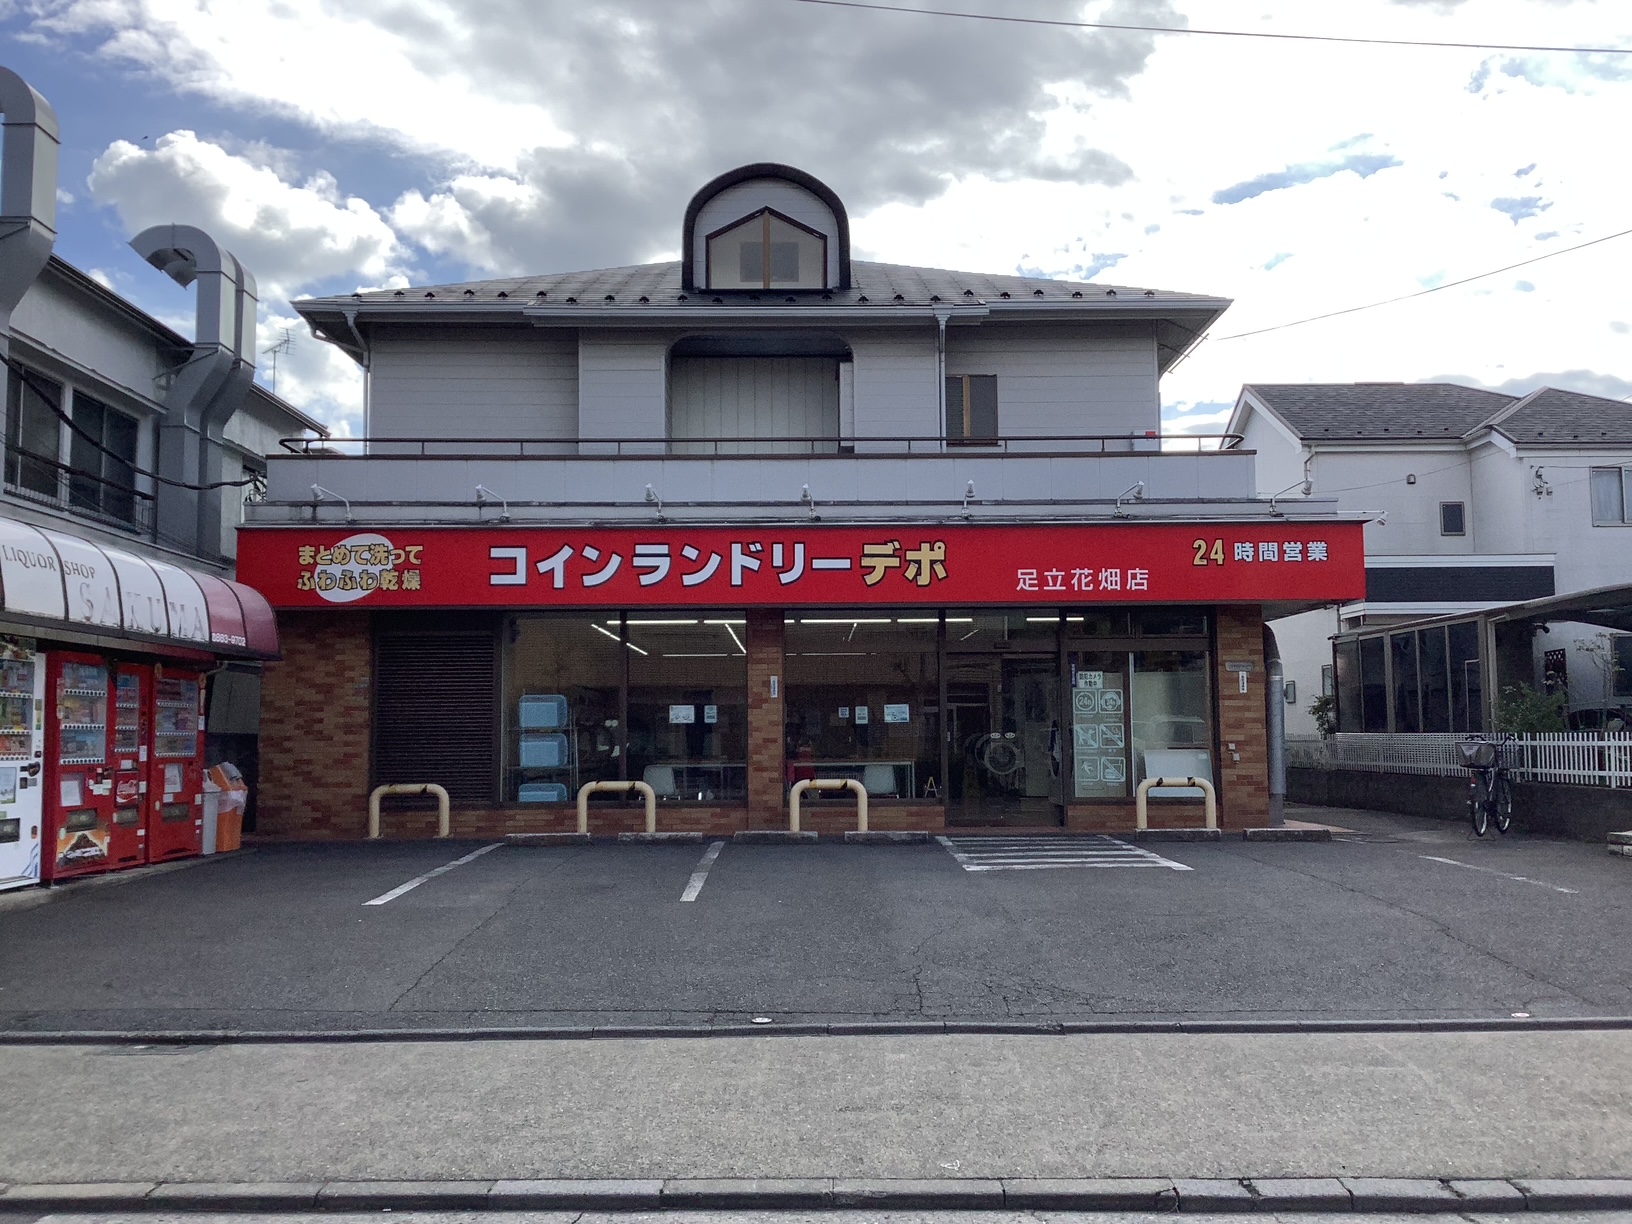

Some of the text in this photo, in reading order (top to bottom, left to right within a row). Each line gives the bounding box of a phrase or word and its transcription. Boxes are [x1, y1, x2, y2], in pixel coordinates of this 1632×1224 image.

[2, 545, 96, 579] LIQUOR SHOP
[297, 543, 424, 566] まとめて洗って
[488, 541, 948, 588] コインランドリーデポ
[296, 568, 422, 591] ふわふわ乾燥
[1015, 568, 1150, 592] 足立花畑店
[80, 582, 207, 640] SAKUMA
